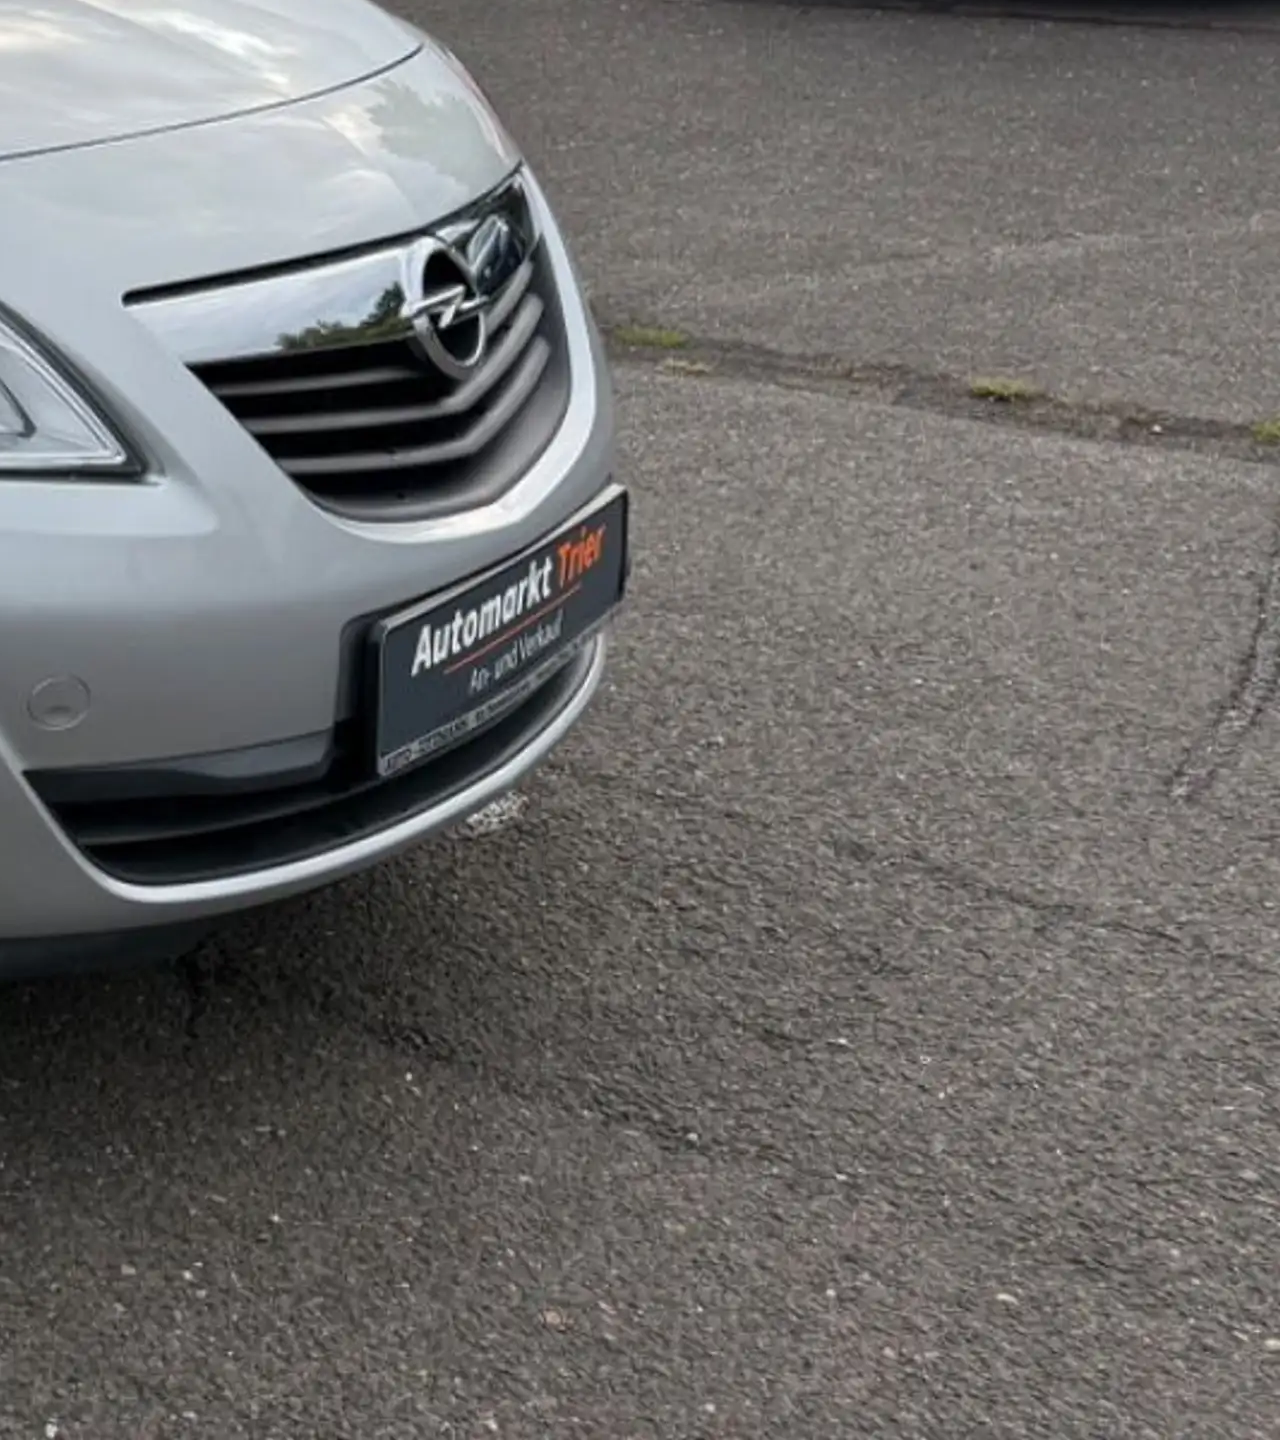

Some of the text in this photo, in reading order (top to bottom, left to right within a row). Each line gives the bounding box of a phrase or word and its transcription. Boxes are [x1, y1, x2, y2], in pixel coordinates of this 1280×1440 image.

[411, 523, 607, 677] Automarkt Trier
[469, 608, 565, 695] An- und Verkauf
